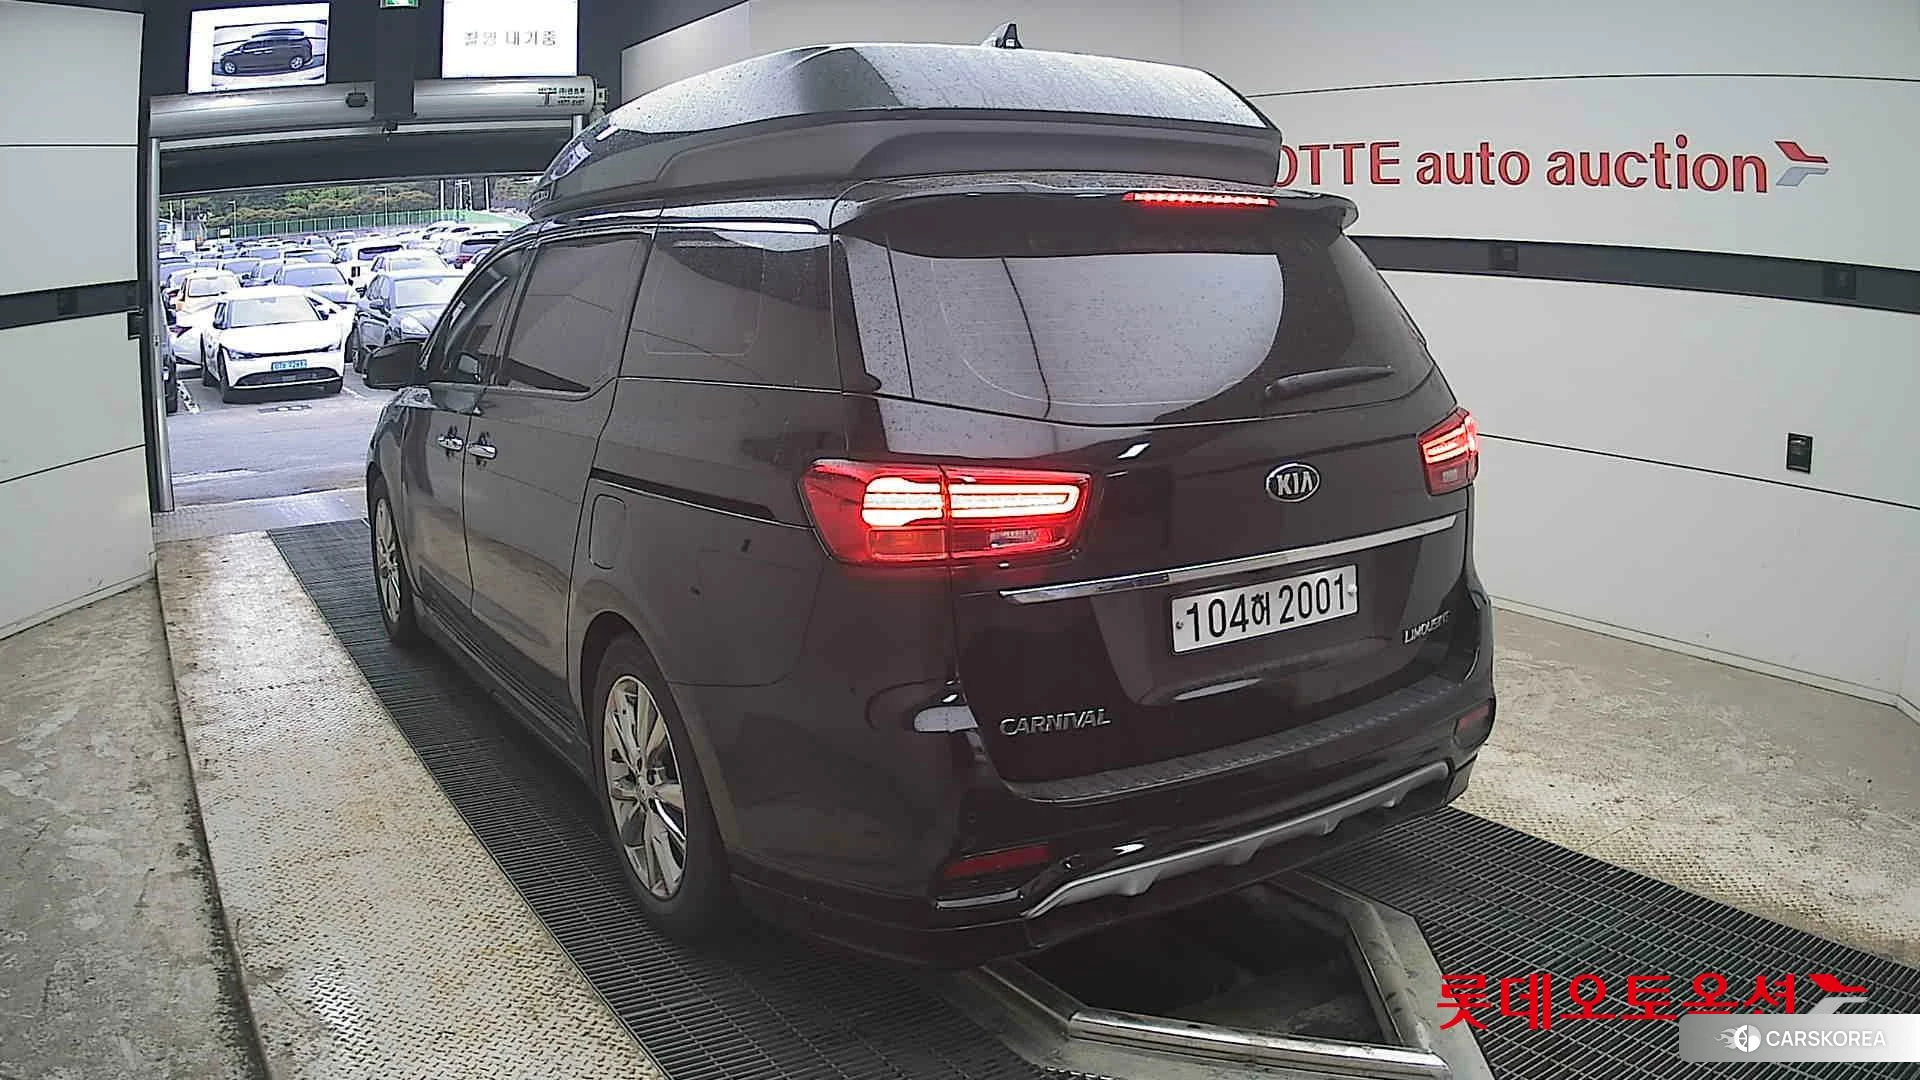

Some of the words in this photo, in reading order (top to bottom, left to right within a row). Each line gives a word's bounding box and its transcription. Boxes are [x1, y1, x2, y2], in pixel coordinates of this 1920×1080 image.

[504, 29, 557, 47] 대기중
[1416, 142, 1531, 187] auto
[1546, 134, 1768, 194] auction
[1276, 471, 1313, 496] KIA
[1186, 591, 1271, 643] 104허
[1278, 573, 1345, 625] 2001
[1000, 708, 1112, 736] CARNIVAL
